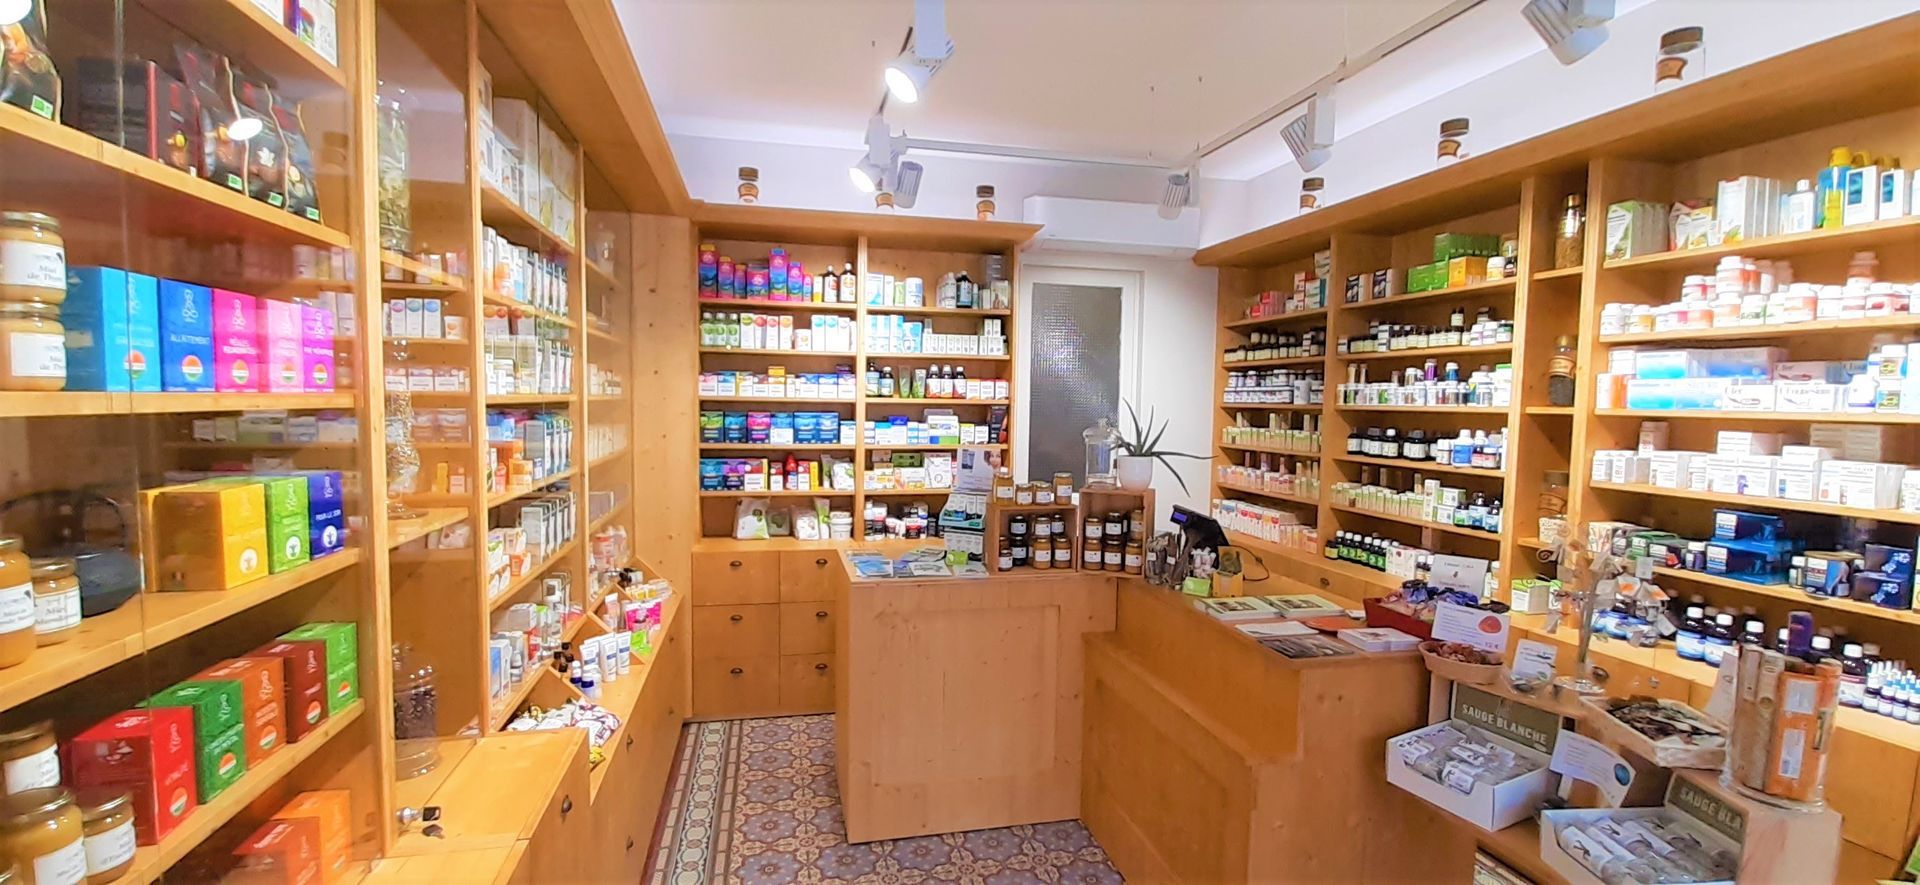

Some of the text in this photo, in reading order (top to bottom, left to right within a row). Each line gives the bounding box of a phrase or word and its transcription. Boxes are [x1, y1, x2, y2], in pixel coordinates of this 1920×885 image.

[1462, 704, 1548, 745] SAUGE BLANCHE
[1680, 786, 1717, 816] SAUGE
